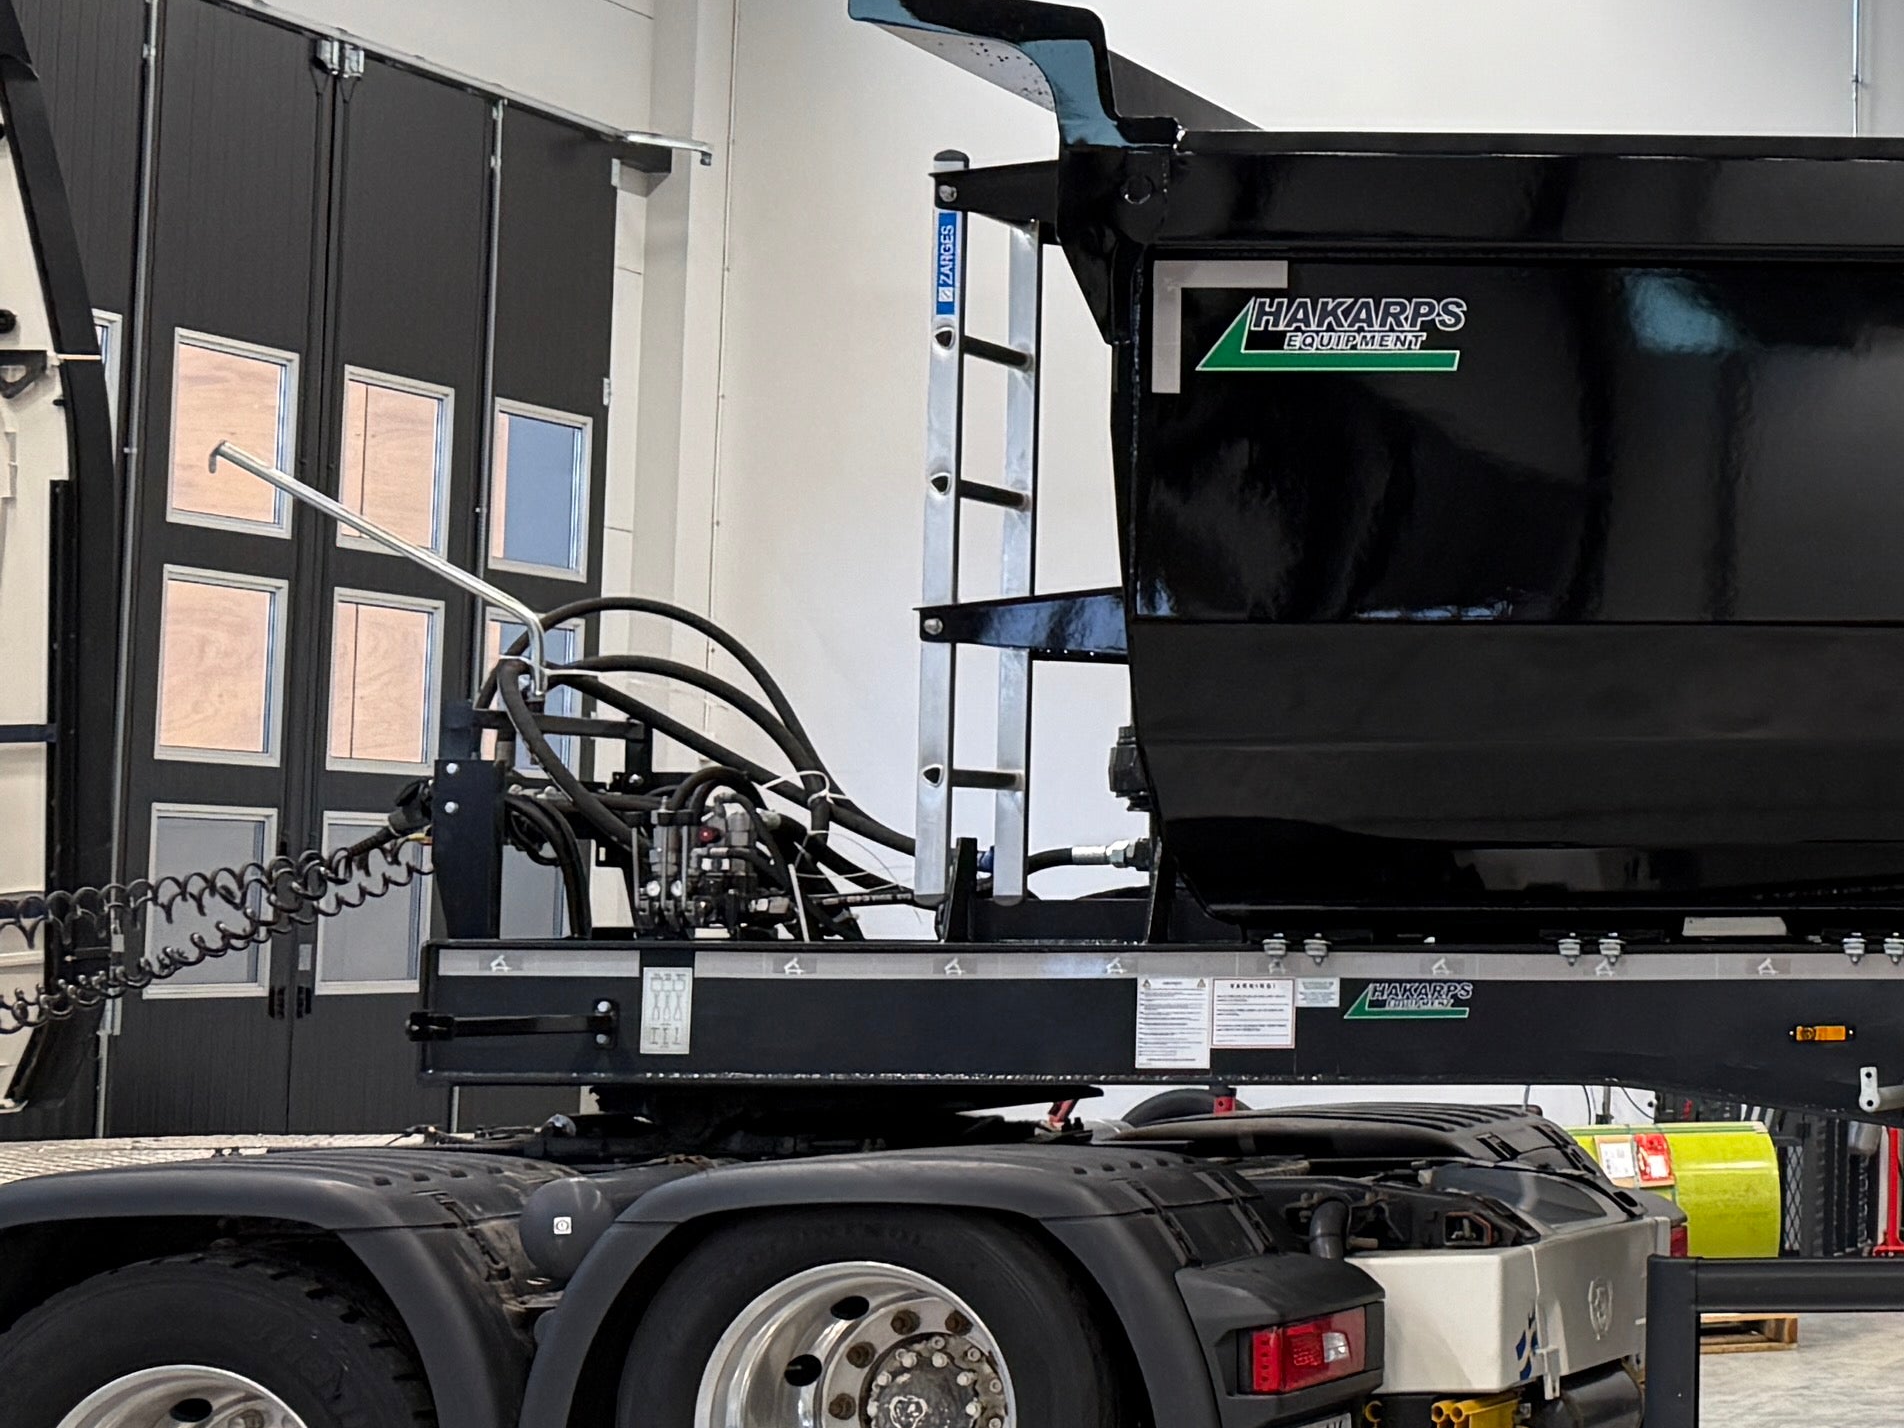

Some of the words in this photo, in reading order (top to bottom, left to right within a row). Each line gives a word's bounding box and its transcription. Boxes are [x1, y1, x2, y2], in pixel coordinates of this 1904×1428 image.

[940, 224, 955, 285] ZARGES
[1250, 298, 1467, 331] HAKARPS
[1284, 332, 1427, 351] EQUIPMENT
[1368, 982, 1473, 1000] HAKARPS
